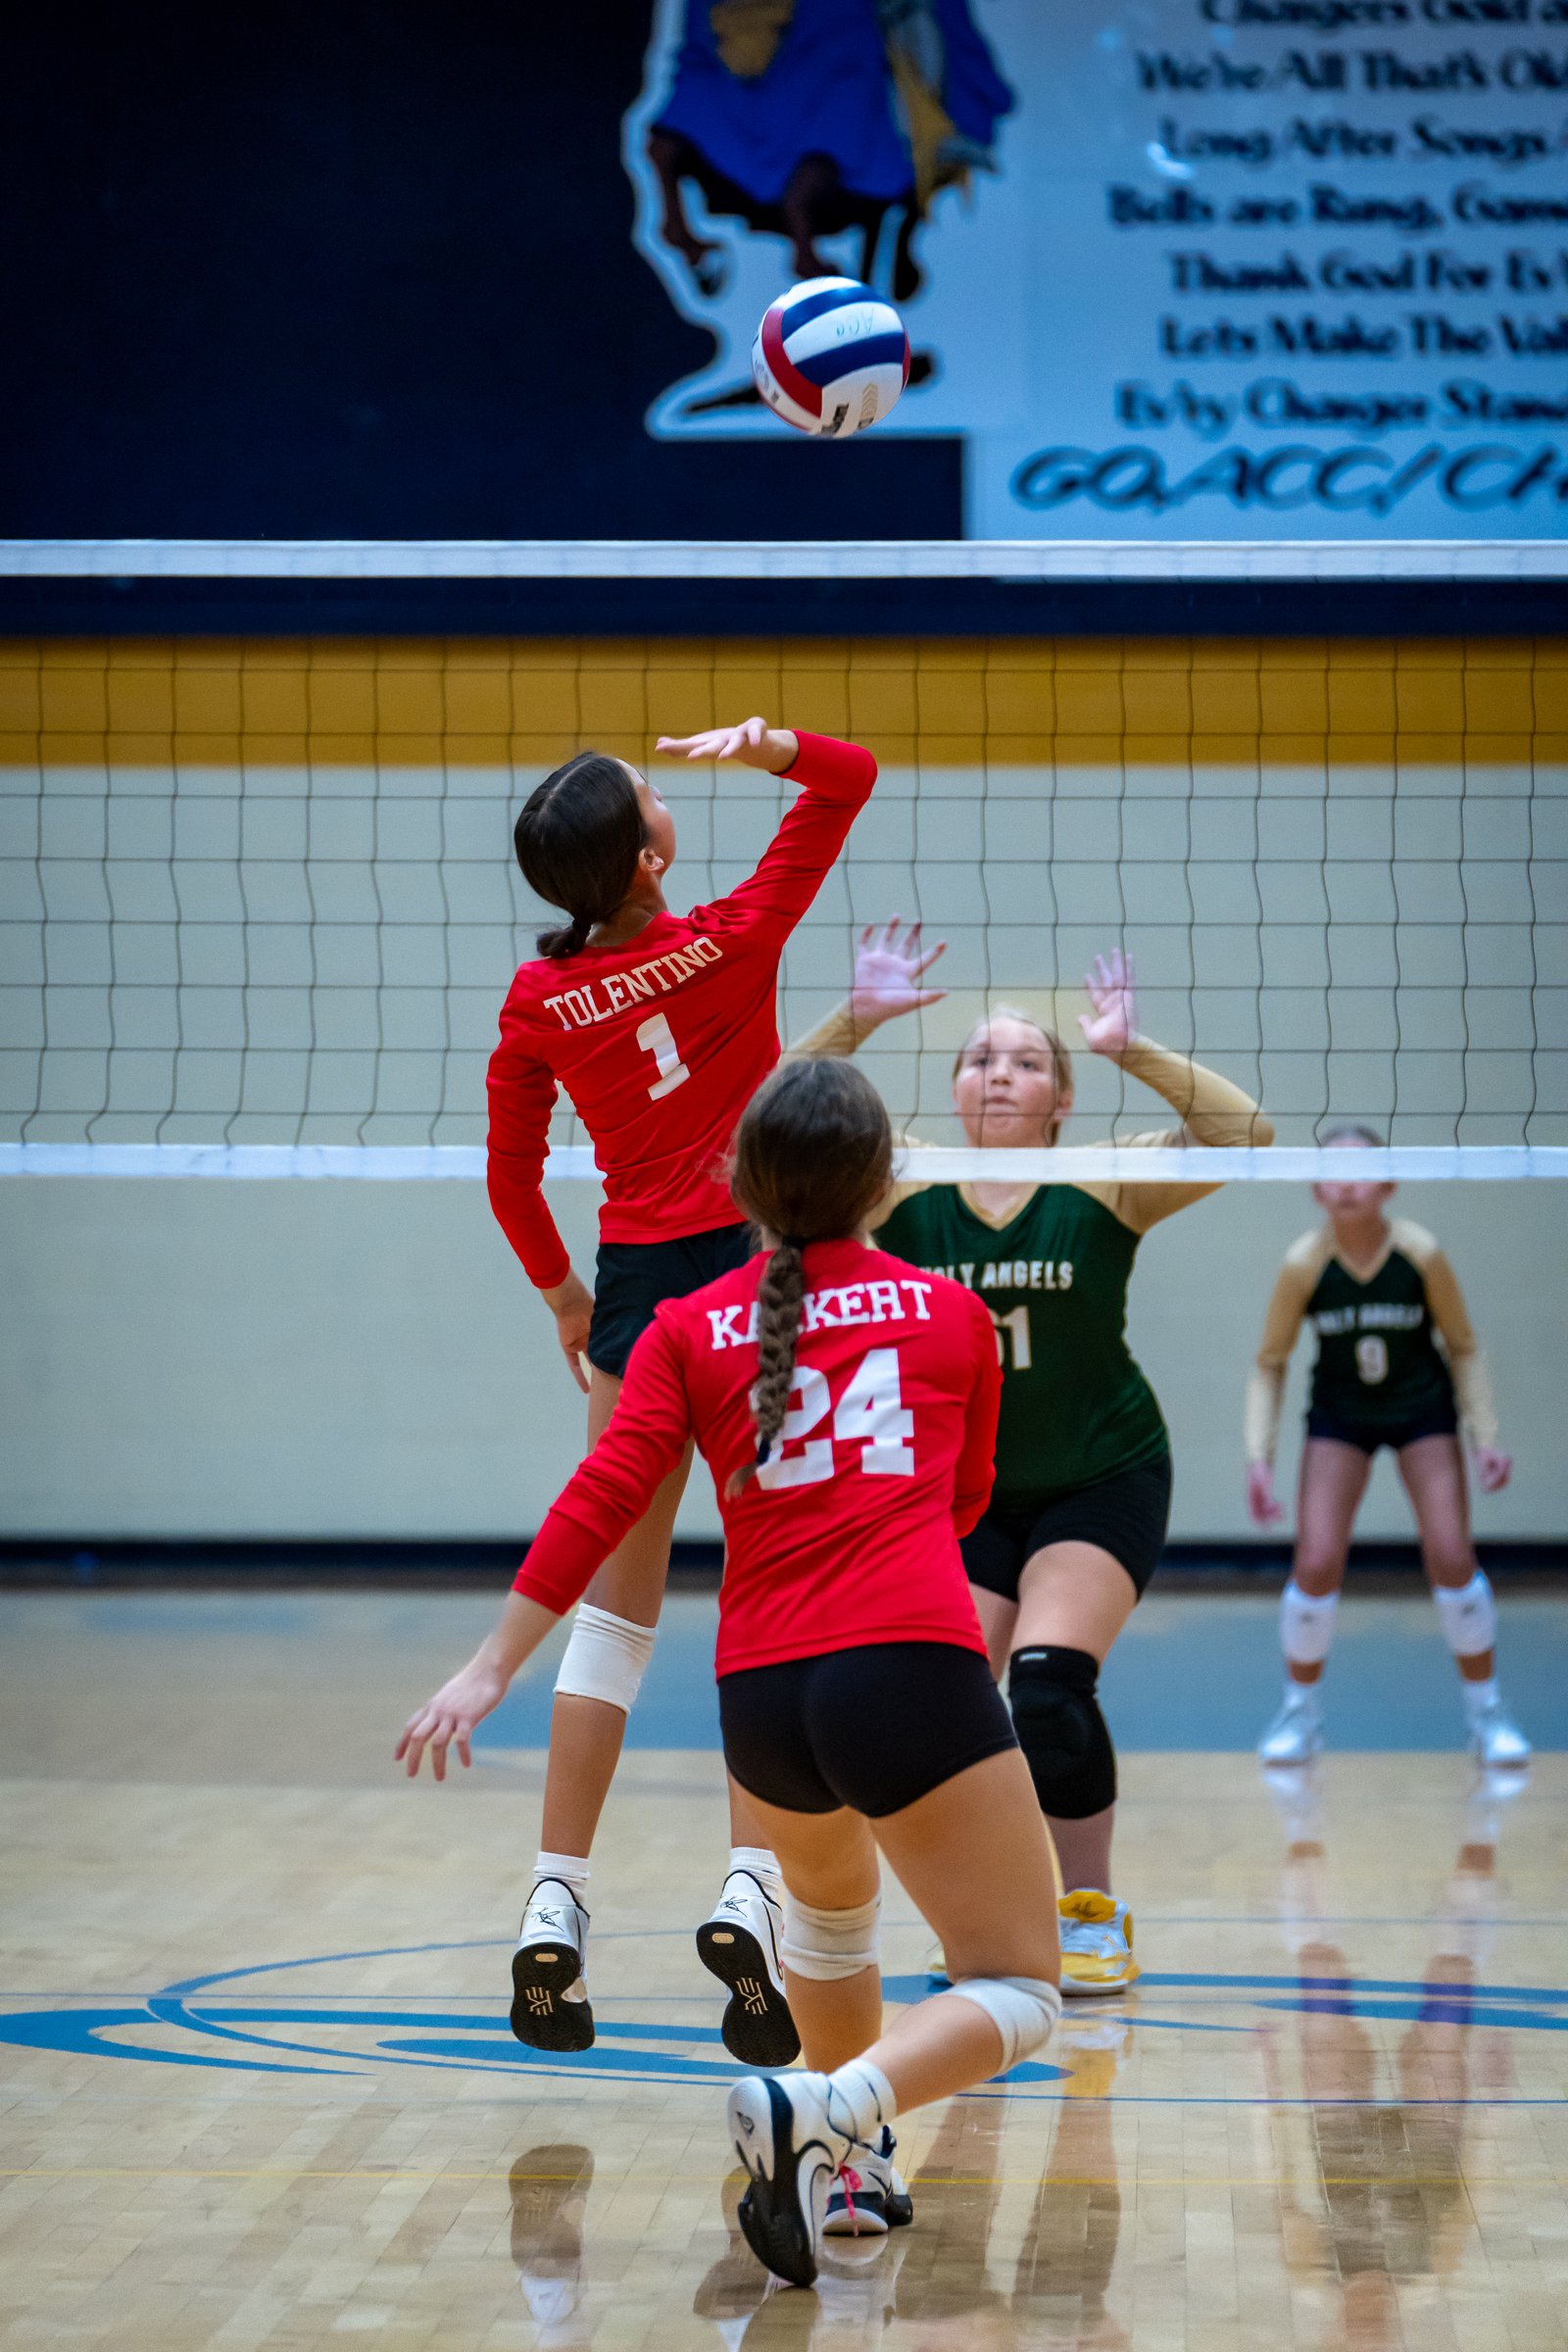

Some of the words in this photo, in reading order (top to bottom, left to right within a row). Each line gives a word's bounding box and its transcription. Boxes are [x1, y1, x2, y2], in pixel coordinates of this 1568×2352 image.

[1166, 248, 1312, 294] Thank
[1319, 247, 1416, 294] God
[1402, 313, 1493, 359] The
[542, 936, 724, 1032] TOLENTINO
[635, 1011, 692, 1102] 1
[981, 1259, 1074, 1292] ANGELS
[749, 1347, 915, 1492] 24
